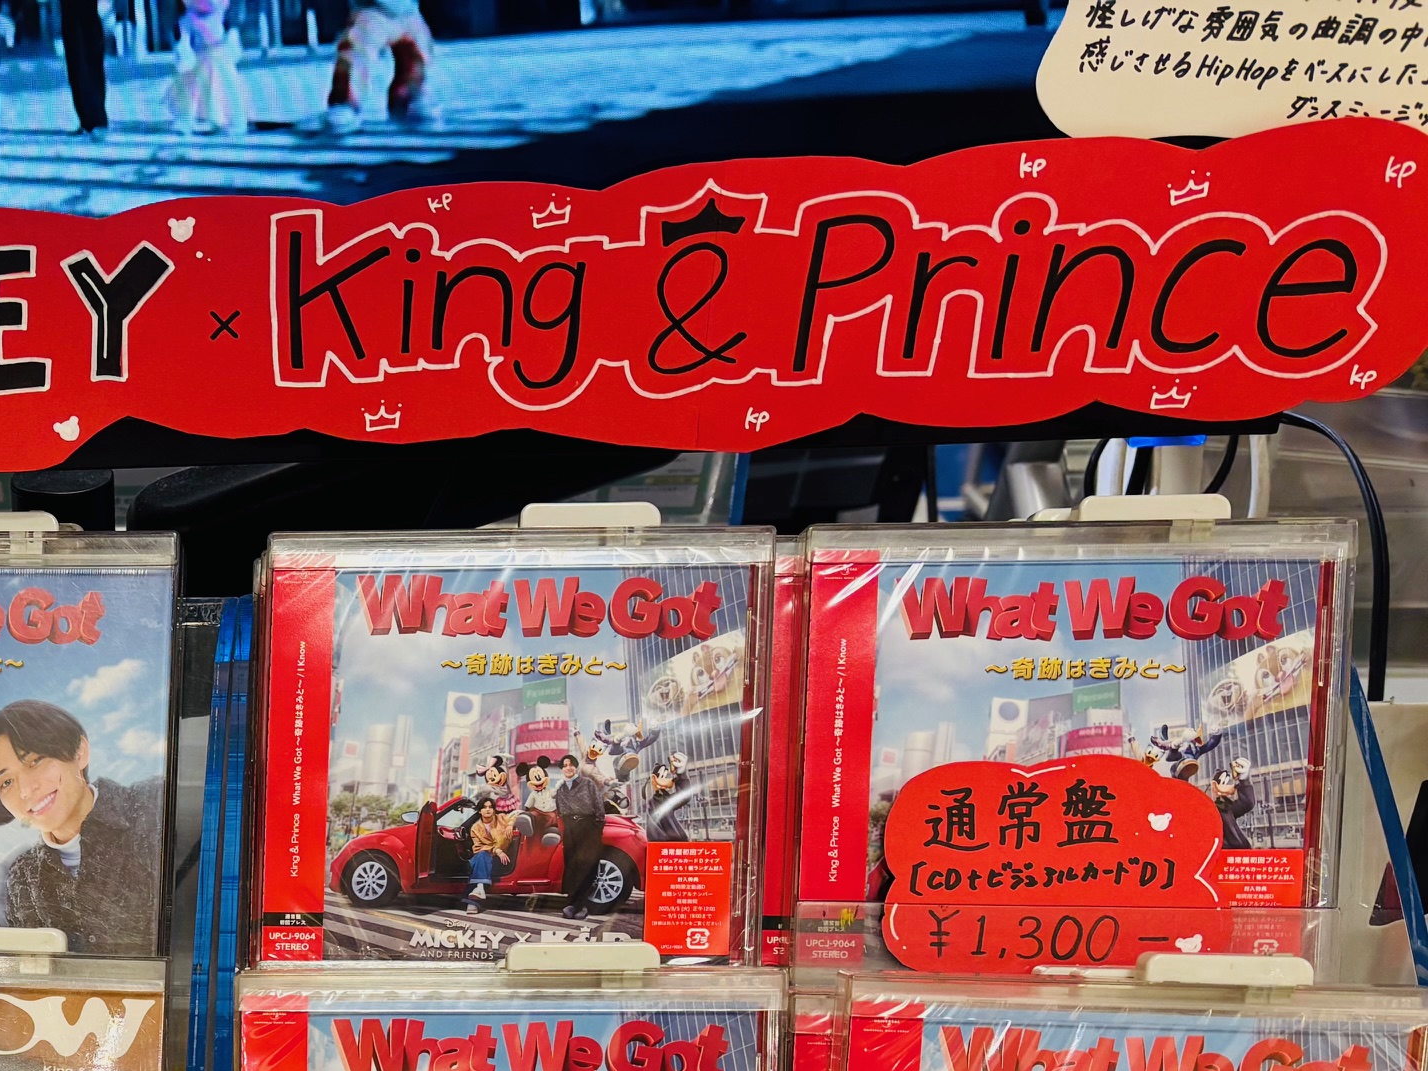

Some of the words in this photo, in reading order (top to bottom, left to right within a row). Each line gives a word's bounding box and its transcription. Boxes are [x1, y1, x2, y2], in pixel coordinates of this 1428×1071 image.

[1085, 0, 1428, 53] 怪しげな雰囲気の曲調の中
[290, 230, 587, 390] King
[647, 241, 748, 375] &
[793, 213, 1358, 373] Prince
[6, 586, 107, 645] Got
[356, 574, 508, 637] What
[513, 576, 605, 638] We
[608, 577, 724, 640] Got
[895, 575, 1059, 641] What
[1063, 575, 1164, 642] We
[1167, 575, 1288, 641] Got
[922, 778, 1119, 851] 通常盤
[268, 931, 316, 941] UPCJ-9064
[274, 942, 310, 951] STEREO
[408, 928, 506, 951] MICKEY
[420, 950, 443, 959] AND
[448, 951, 495, 960] FRIENDS
